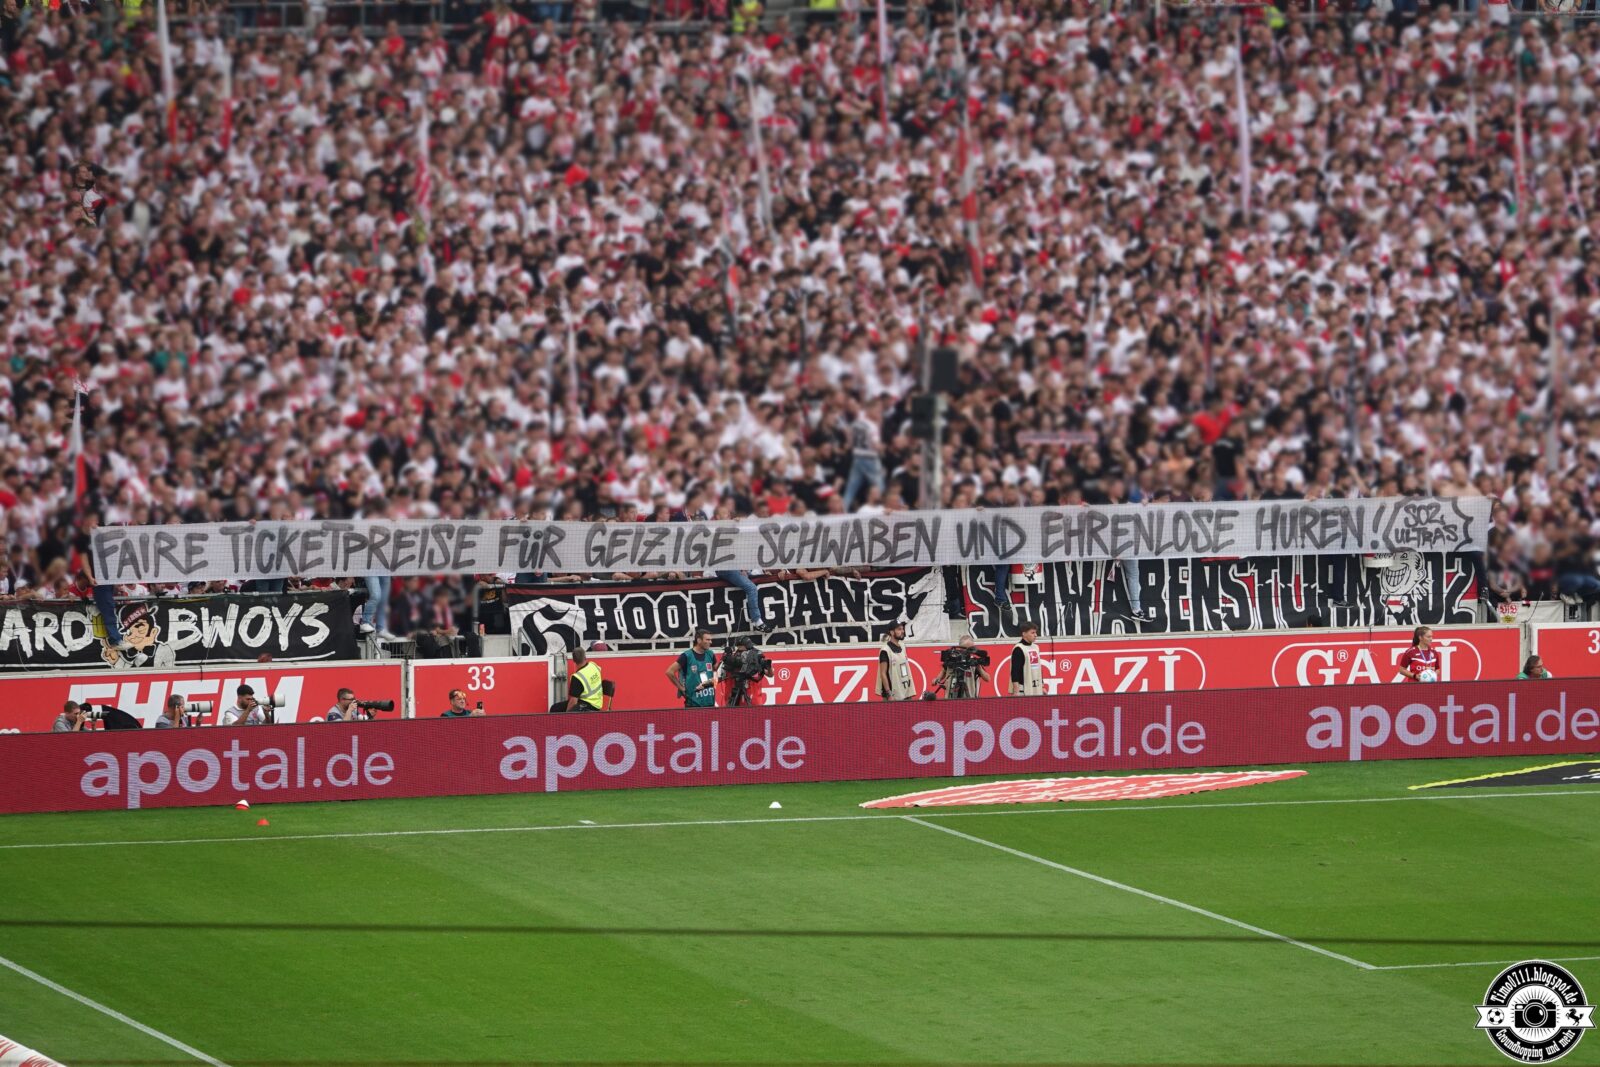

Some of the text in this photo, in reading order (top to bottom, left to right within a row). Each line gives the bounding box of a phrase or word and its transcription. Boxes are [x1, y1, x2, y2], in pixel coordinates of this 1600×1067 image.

[94, 529, 209, 580] FAIRE
[584, 522, 740, 568] GEIZIGE
[757, 516, 942, 567] SCHWABEN
[956, 514, 1026, 561] UND
[1040, 508, 1239, 558] EHRENLOSE
[1394, 523, 1459, 550] ULTRAS
[167, 602, 331, 652] BWOYS
[574, 577, 907, 640] HOOLIGANS
[467, 665, 495, 691] 33
[80, 735, 395, 809] apotal.de
[499, 719, 807, 792] apotal.de
[908, 704, 1206, 777] apotal.de
[1305, 691, 1600, 761] apotal.de
